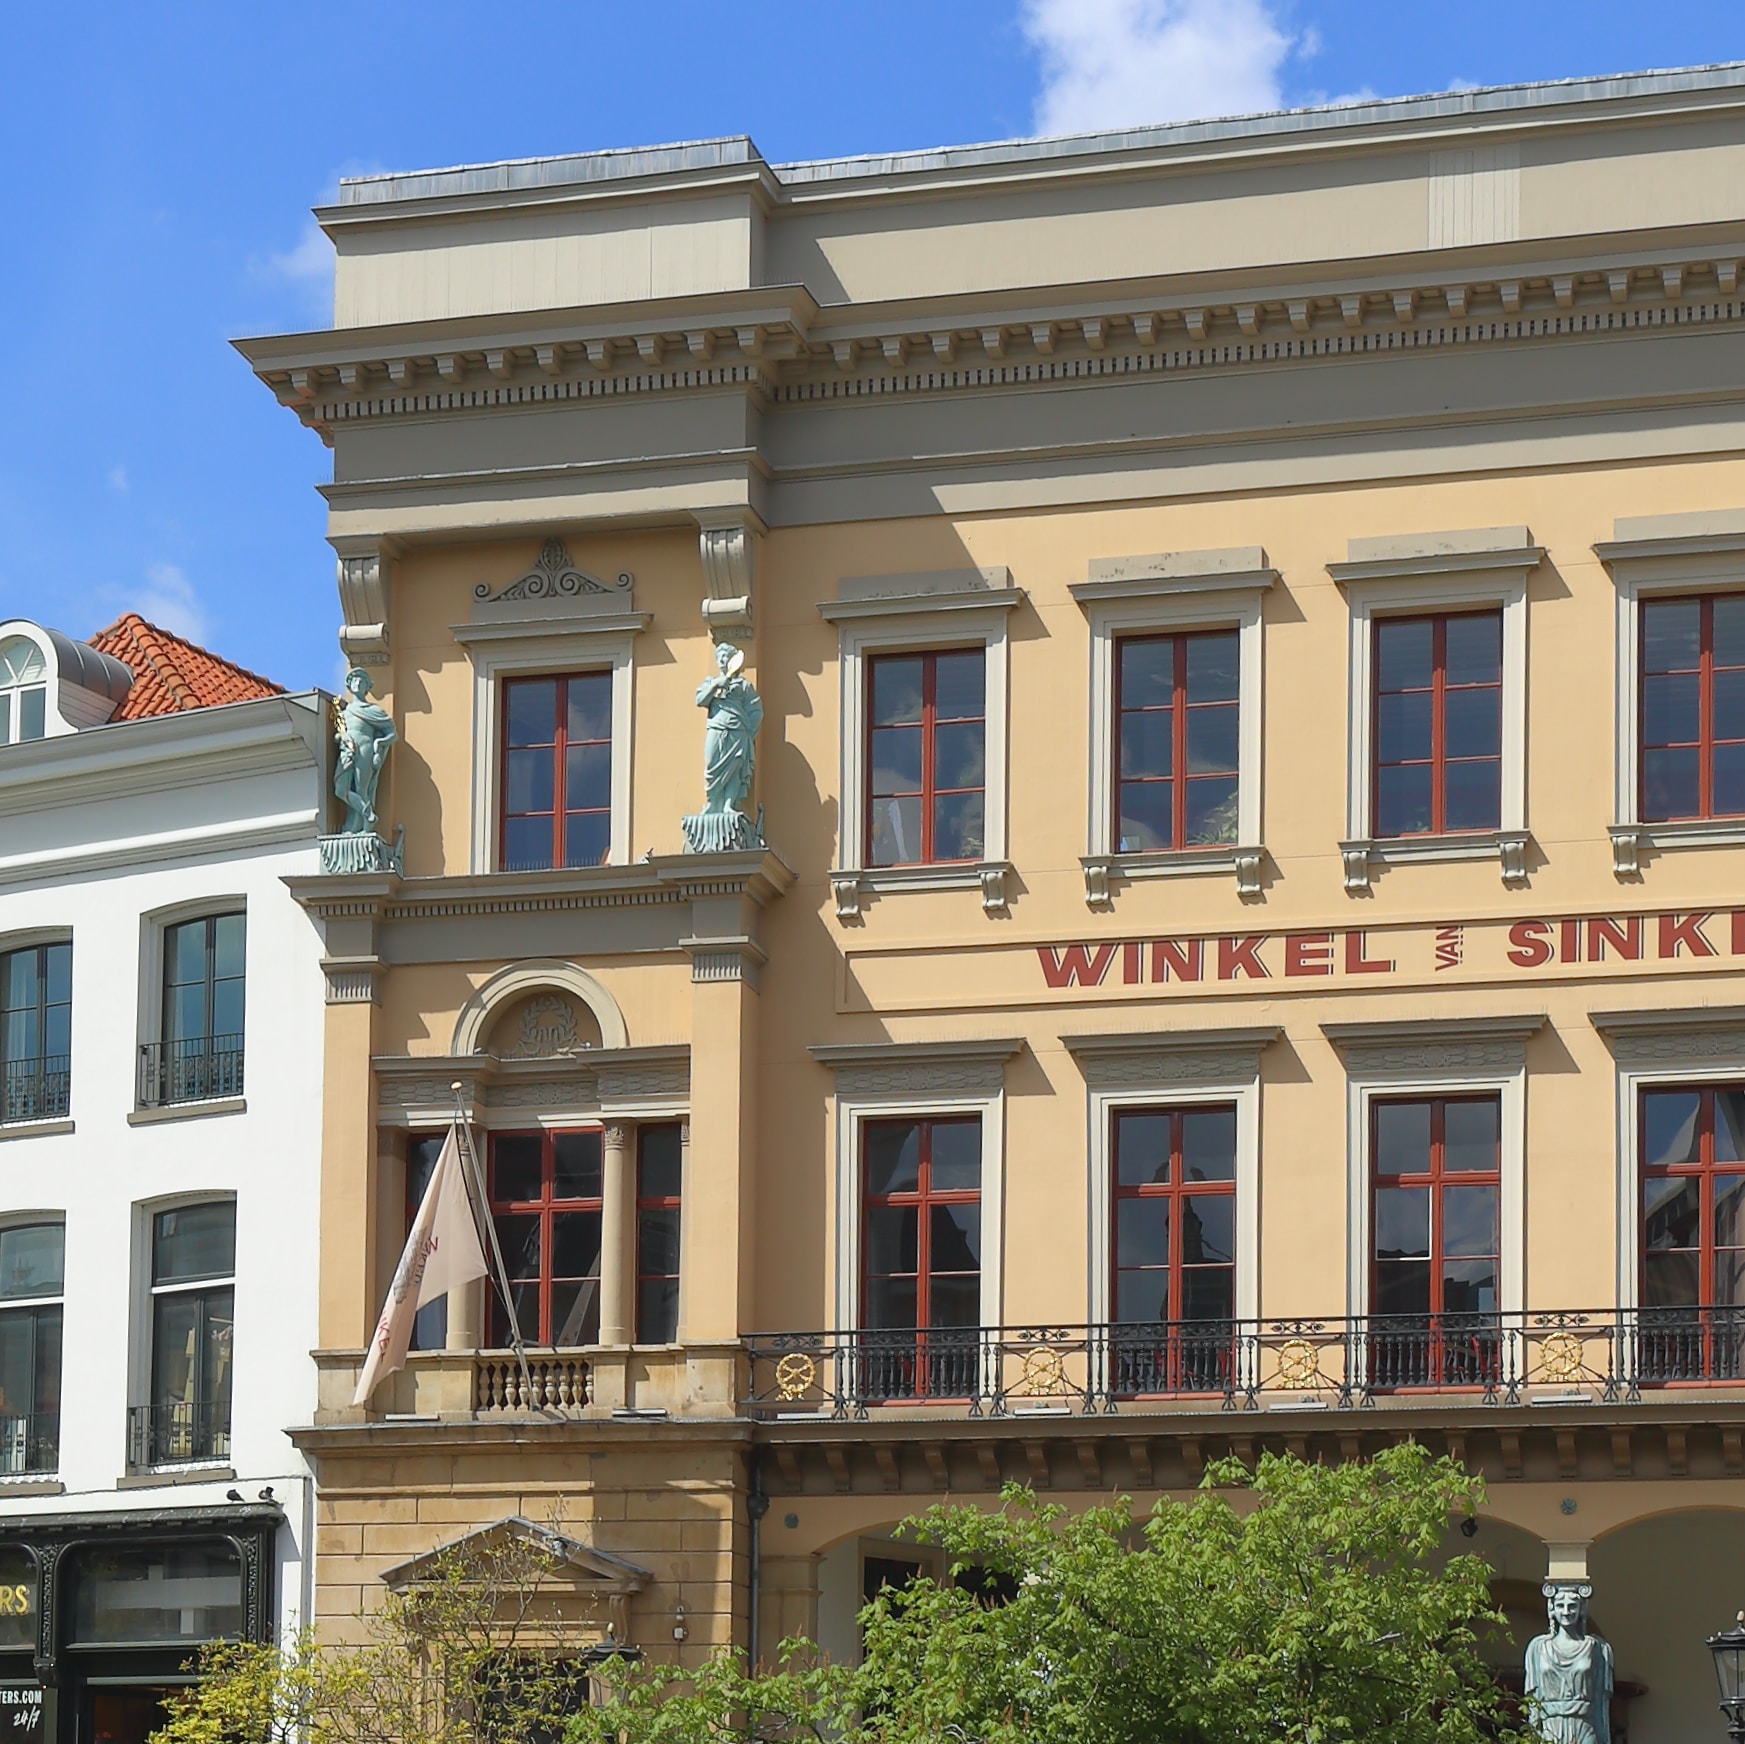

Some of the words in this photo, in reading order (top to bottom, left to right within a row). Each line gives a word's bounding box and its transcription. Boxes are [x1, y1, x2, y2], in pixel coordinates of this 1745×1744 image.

[1035, 930, 1396, 989] WINKEL
[1432, 924, 1464, 972] VAN
[13, 1705, 41, 1732] 24/7
